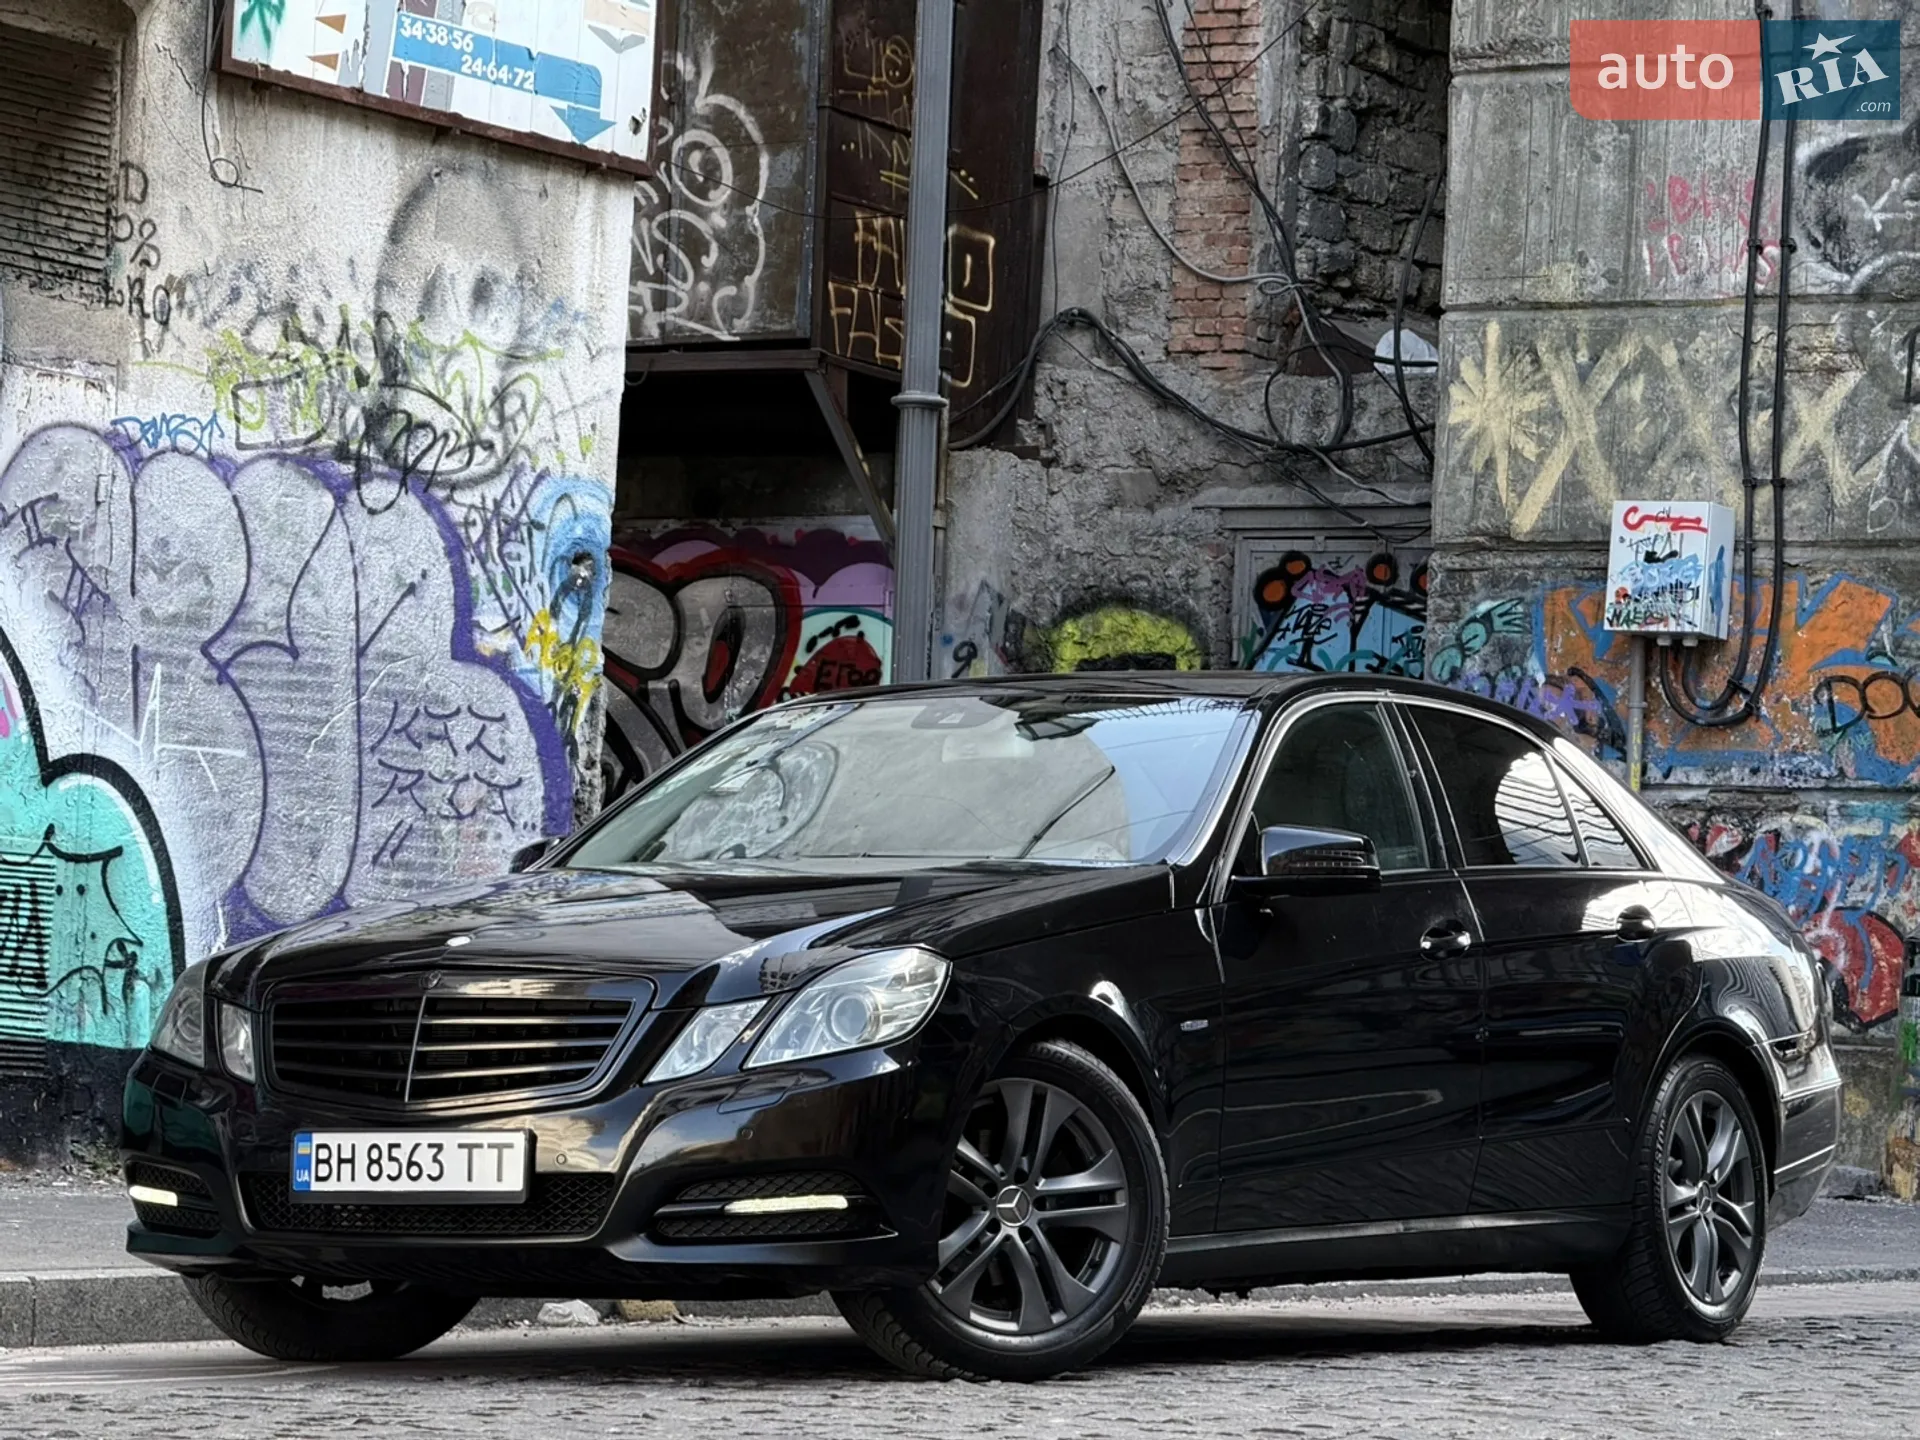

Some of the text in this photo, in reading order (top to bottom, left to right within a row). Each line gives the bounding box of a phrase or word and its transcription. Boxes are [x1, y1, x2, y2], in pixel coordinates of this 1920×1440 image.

[296, 1169, 310, 1183] UA
[314, 1142, 516, 1183] BH 8563 TT
